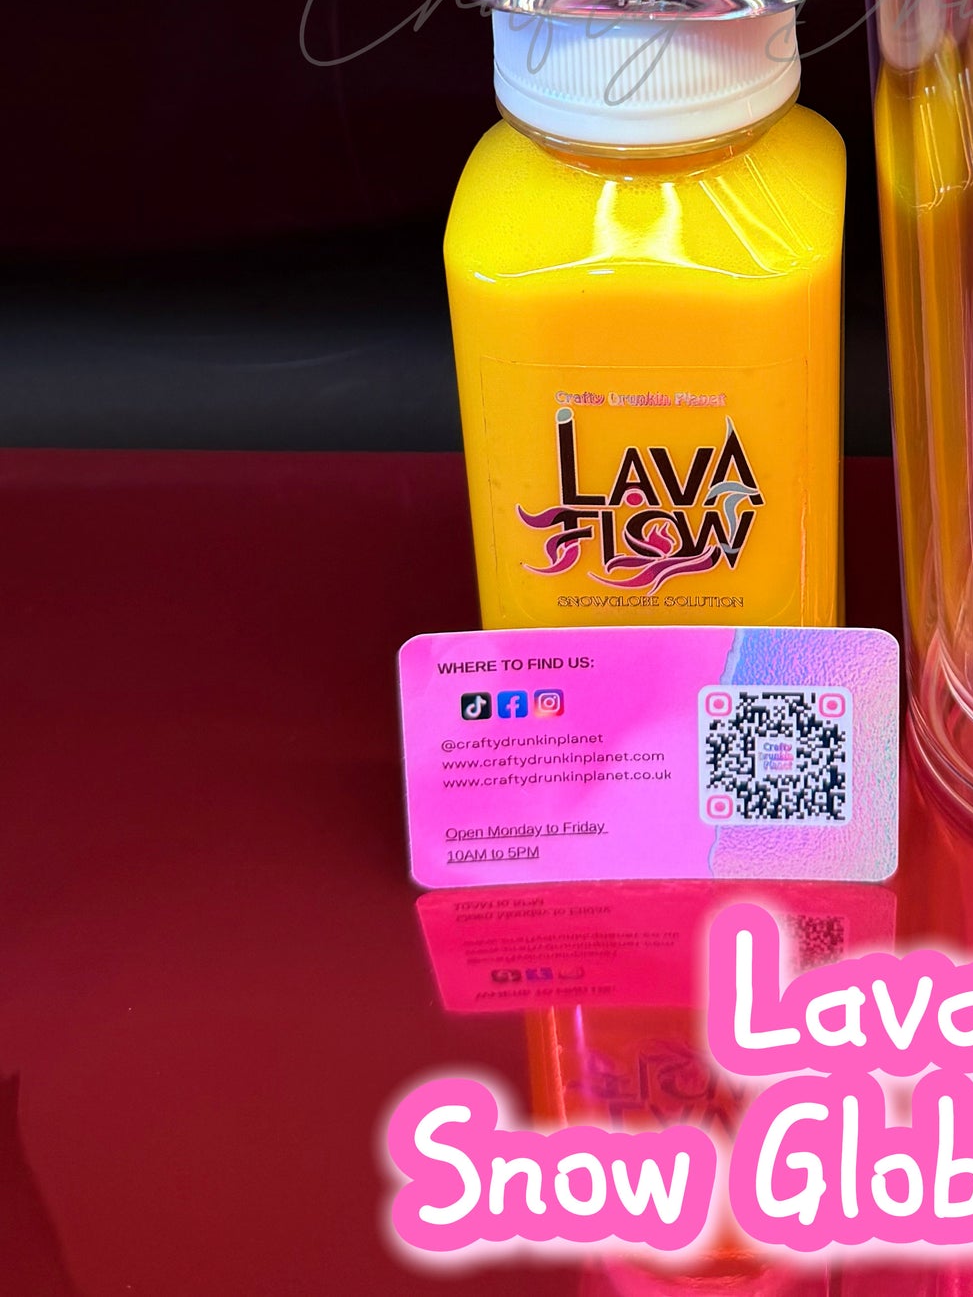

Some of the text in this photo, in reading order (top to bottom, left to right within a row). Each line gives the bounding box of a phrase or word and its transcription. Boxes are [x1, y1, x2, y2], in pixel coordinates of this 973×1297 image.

[554, 406, 765, 508] LAVA
[516, 504, 758, 587] FLOW
[557, 595, 744, 608] SNOWGLOBE SOLUTION
[437, 656, 595, 675] WHERE TO FIND US:
[440, 733, 604, 753] @craftydrunkinplanet
[442, 751, 665, 770] www.craftydrunkinplanet.com
[443, 769, 672, 789] www.craftydrunkinplanet.co.uk
[445, 820, 606, 842] Open Monday to Friday
[447, 845, 540, 864] 10AM to 5PM
